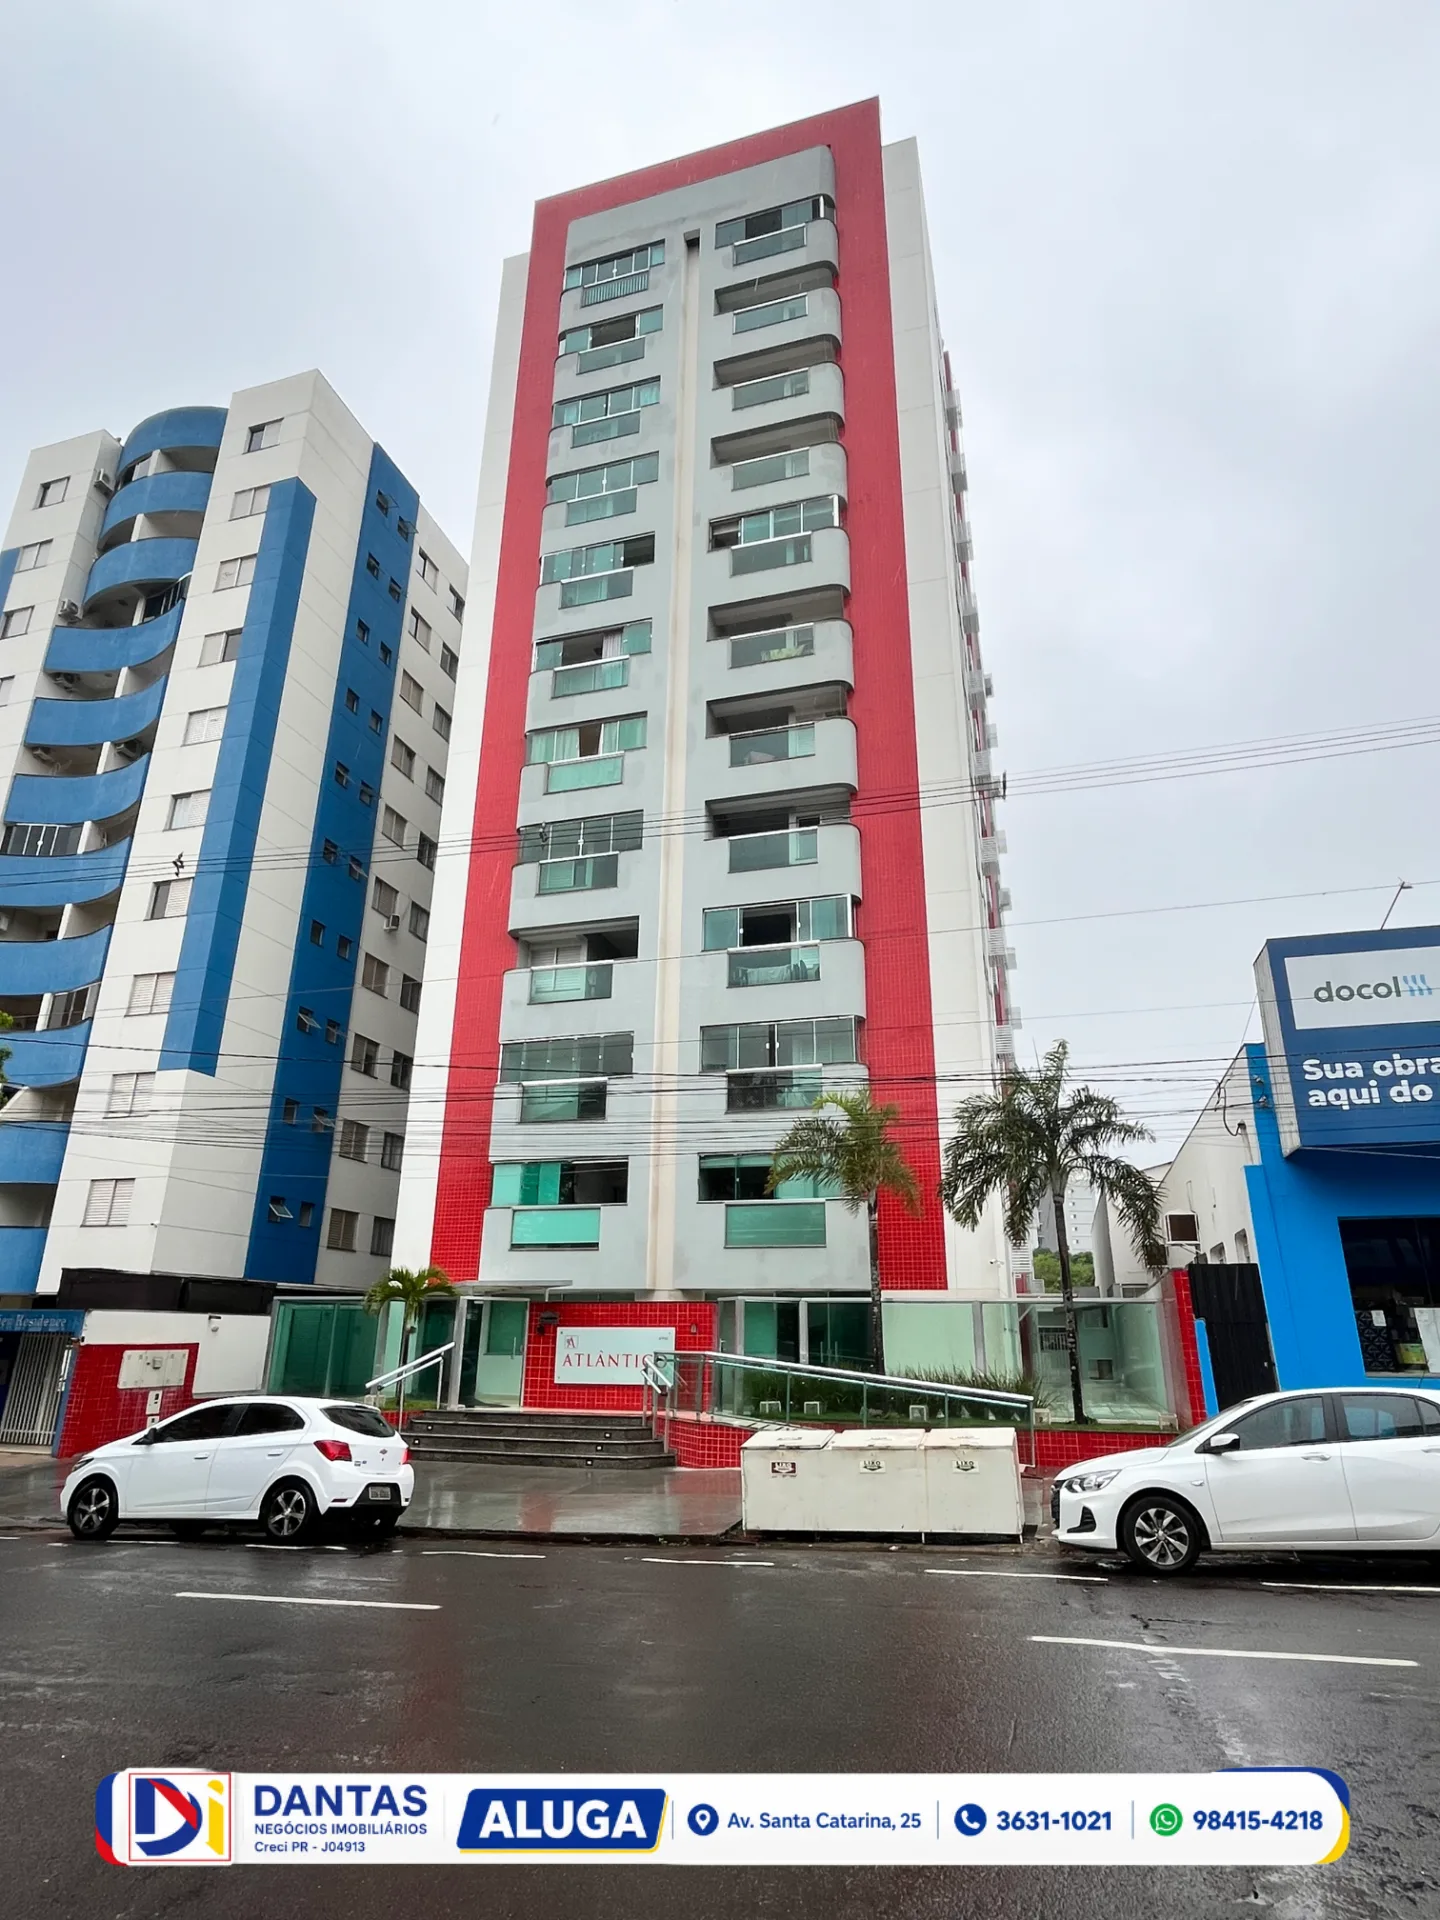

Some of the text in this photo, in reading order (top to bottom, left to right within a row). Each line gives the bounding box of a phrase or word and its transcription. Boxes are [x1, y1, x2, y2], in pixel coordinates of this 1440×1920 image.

[1314, 976, 1402, 1003] docol
[1303, 1058, 1364, 1081] Sua
[1308, 1079, 1433, 1110] aqui do
